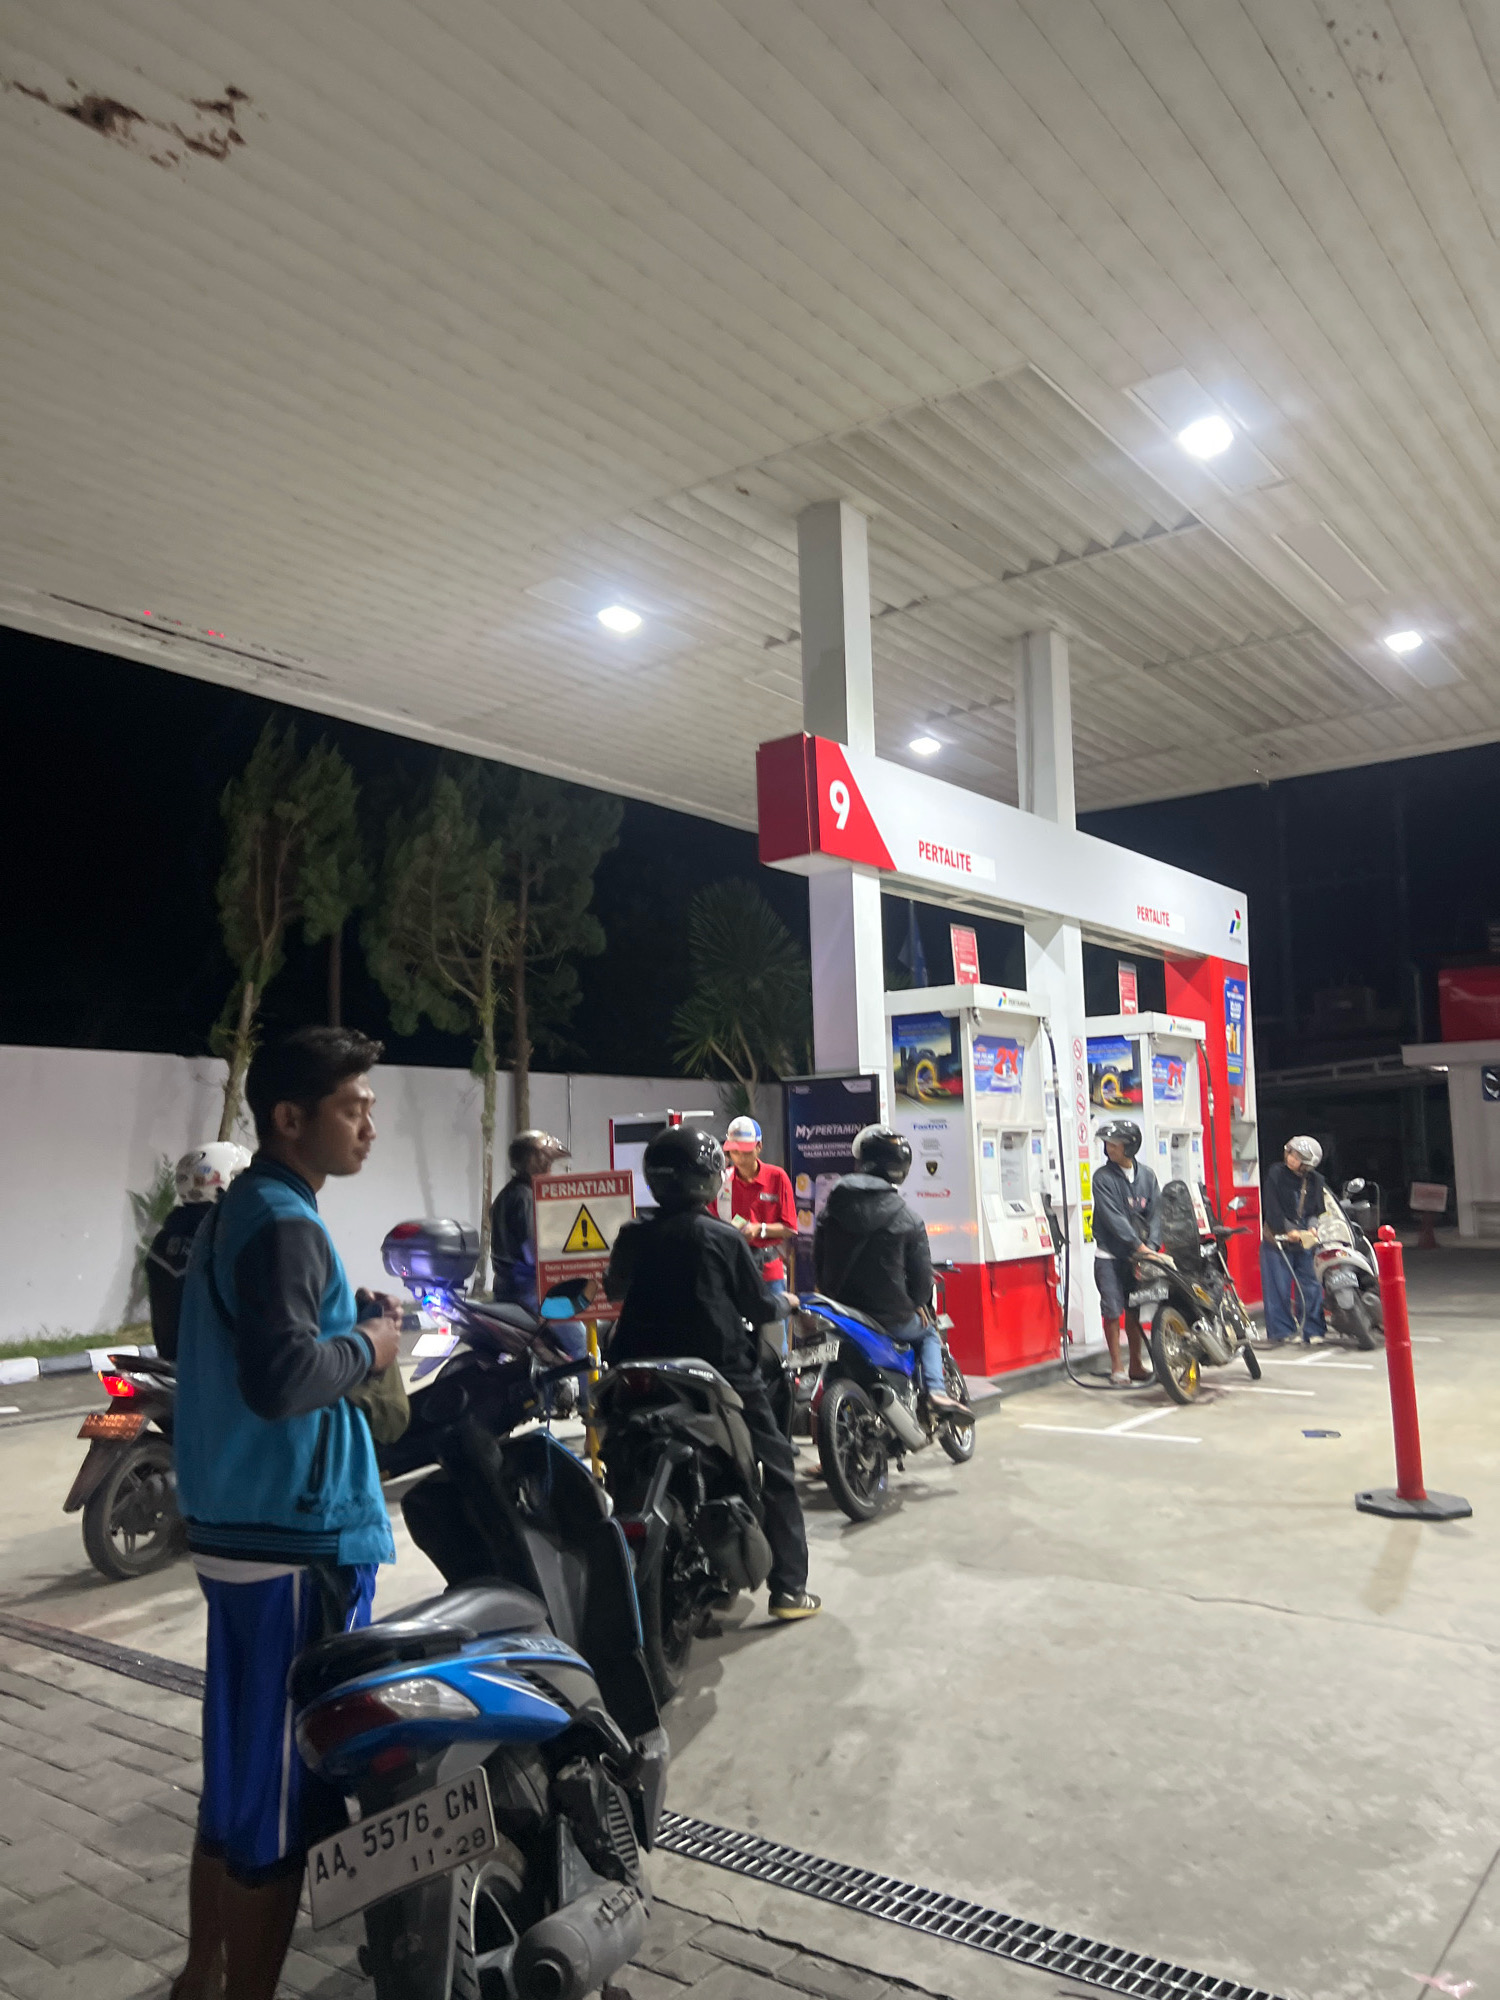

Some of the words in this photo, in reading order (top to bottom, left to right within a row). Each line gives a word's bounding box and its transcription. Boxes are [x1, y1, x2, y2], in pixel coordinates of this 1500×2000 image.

[829, 780, 850, 830] 9
[918, 839, 972, 873] PERTALITE
[1136, 904, 1170, 928] PERTALITE
[913, 1122, 948, 1130] Fastron
[541, 1180, 616, 1198] PERHATIAN
[316, 1842, 348, 1885] AA
[363, 1804, 429, 1857] 5576
[445, 1779, 479, 1820] GN
